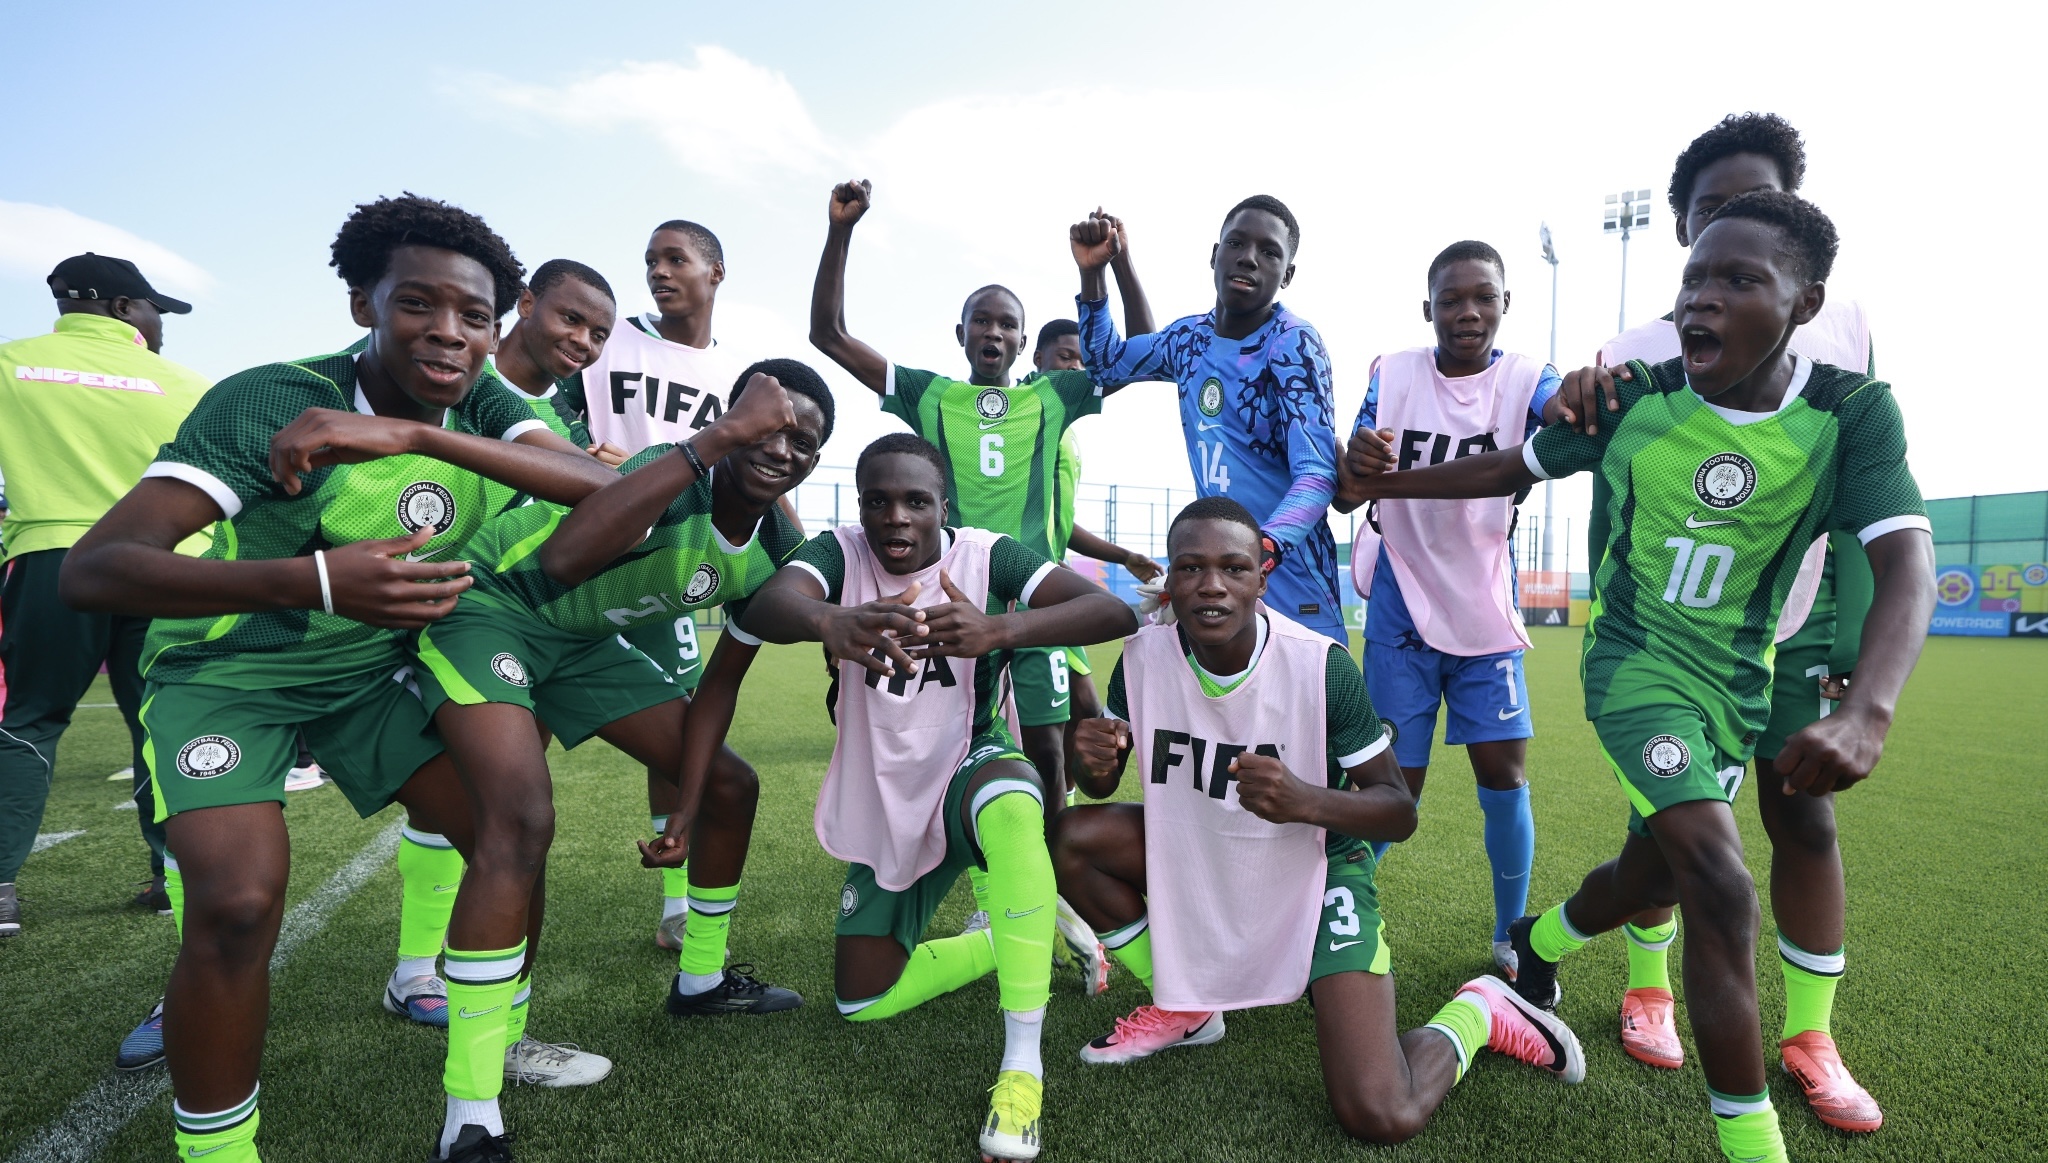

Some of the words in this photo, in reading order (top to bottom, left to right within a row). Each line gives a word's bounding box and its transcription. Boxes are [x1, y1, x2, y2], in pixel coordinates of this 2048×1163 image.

[15, 365, 167, 396] NIGERIA
[609, 371, 725, 431] FIFA
[979, 433, 1005, 477] 6
[1197, 440, 1231, 493] 14
[402, 483, 435, 502] FOOTBALL
[1696, 467, 1708, 495] NIGERIA
[1704, 455, 1742, 469] FOOTBALL
[1735, 462, 1754, 502] FEDERATION
[399, 502, 414, 529] NIGERIA
[435, 487, 453, 526] FEDERATION
[1710, 498, 1726, 506] 1945
[1662, 536, 1736, 608] 10
[673, 616, 699, 661] 9
[1049, 650, 1069, 694] 6
[1495, 658, 1518, 706] 1
[1323, 886, 1361, 937] 3
